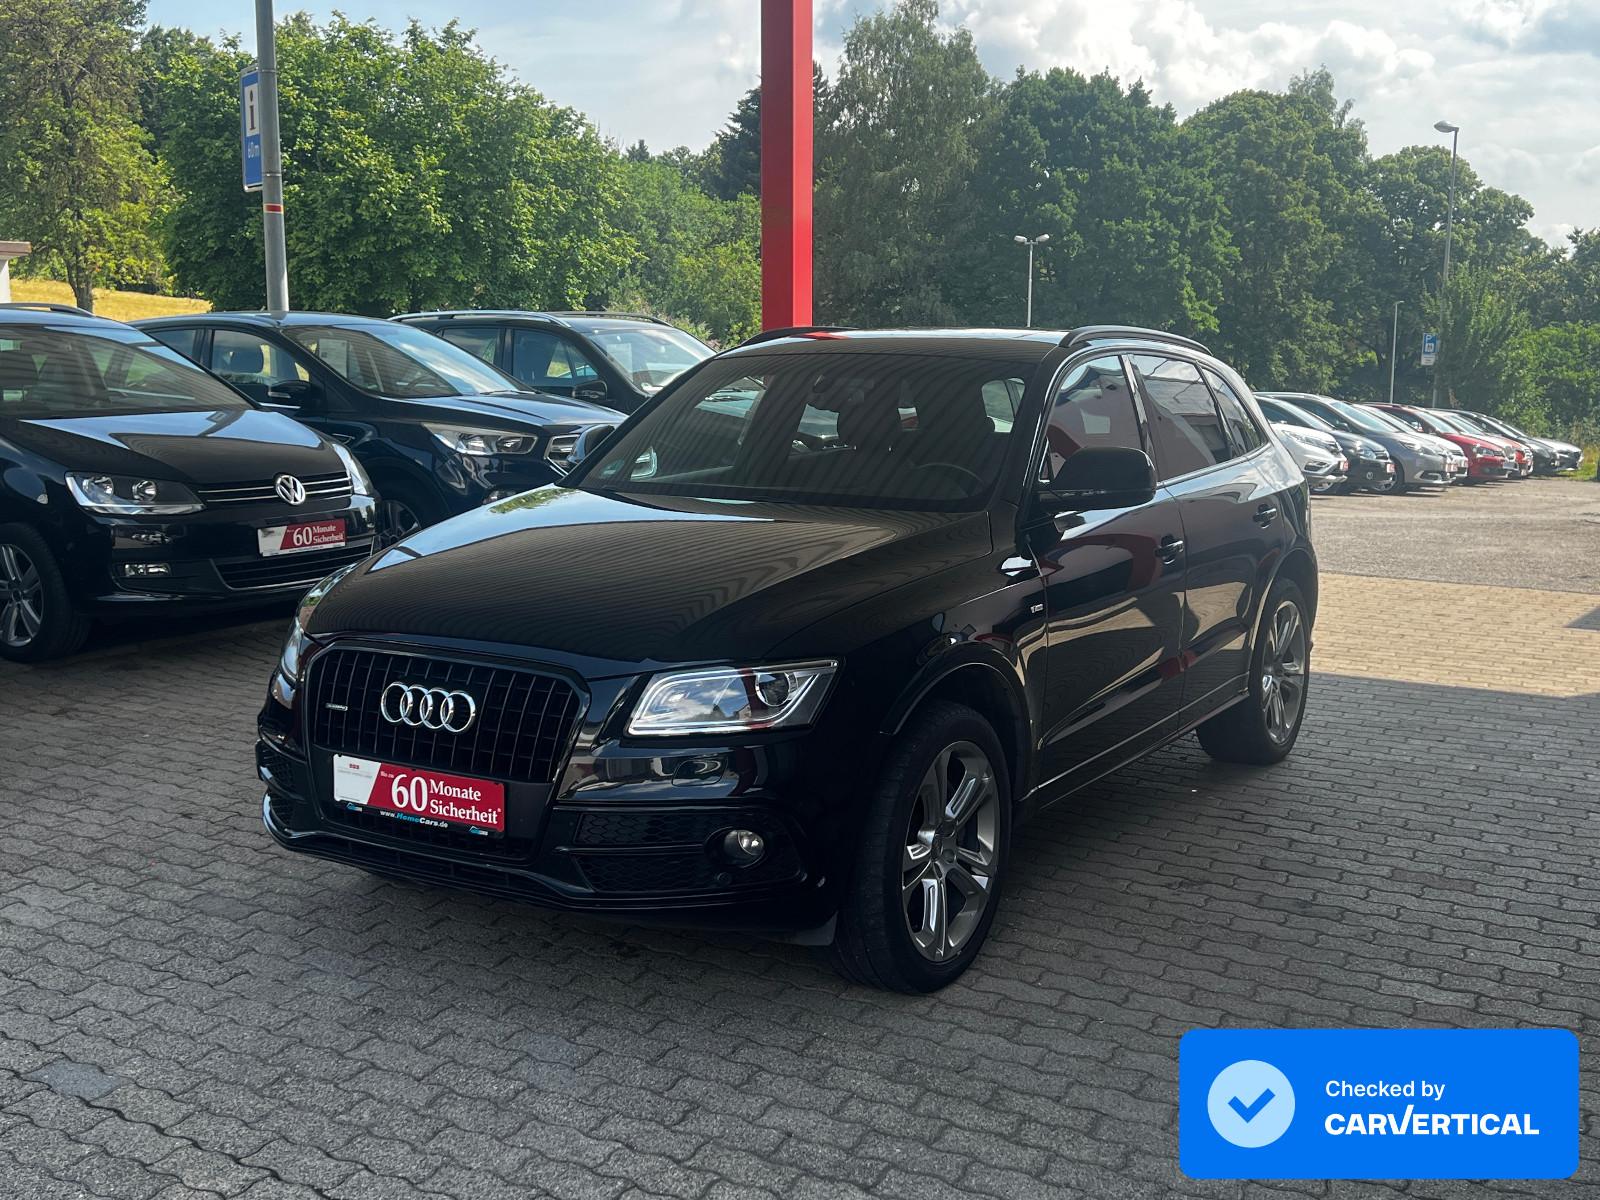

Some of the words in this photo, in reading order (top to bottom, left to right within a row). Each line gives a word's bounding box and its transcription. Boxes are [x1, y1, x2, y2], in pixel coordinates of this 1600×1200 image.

[292, 526, 313, 546] 60
[312, 524, 337, 534] Monate
[391, 773, 428, 812] 60
[429, 778, 482, 801] Monate
[379, 809, 449, 829] www.HomeCars.de
